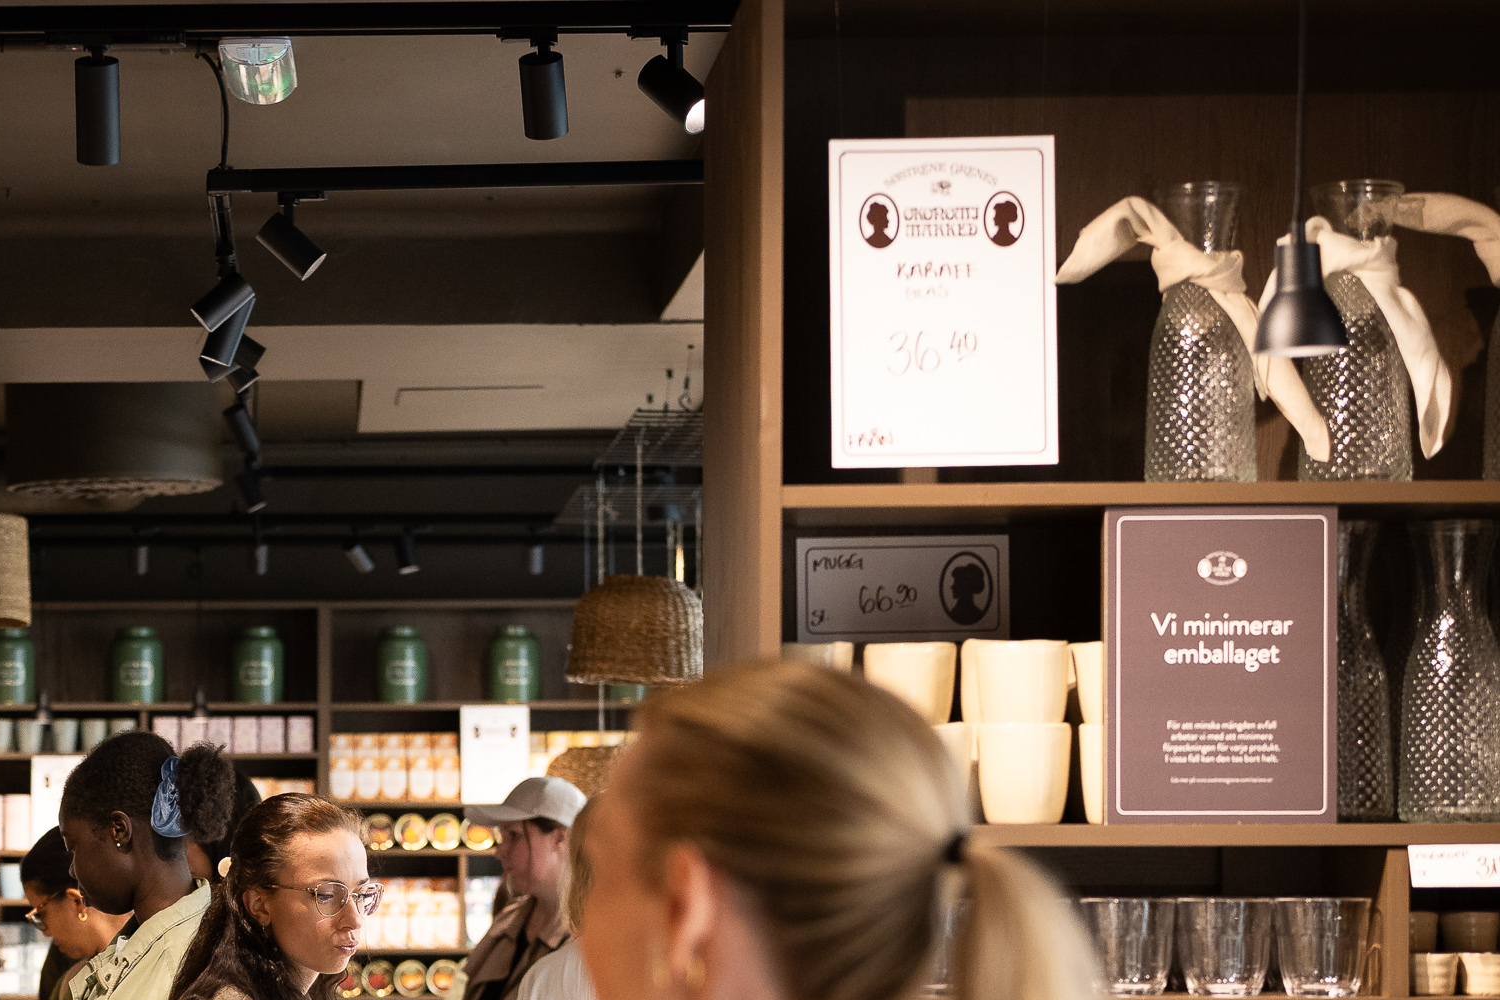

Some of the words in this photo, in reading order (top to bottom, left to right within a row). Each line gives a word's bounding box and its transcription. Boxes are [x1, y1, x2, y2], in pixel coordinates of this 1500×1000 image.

[813, 553, 864, 573] MUGG
[1150, 612, 1177, 636] Vi
[1183, 612, 1294, 636] minimerar
[1163, 640, 1281, 672] emballaget
